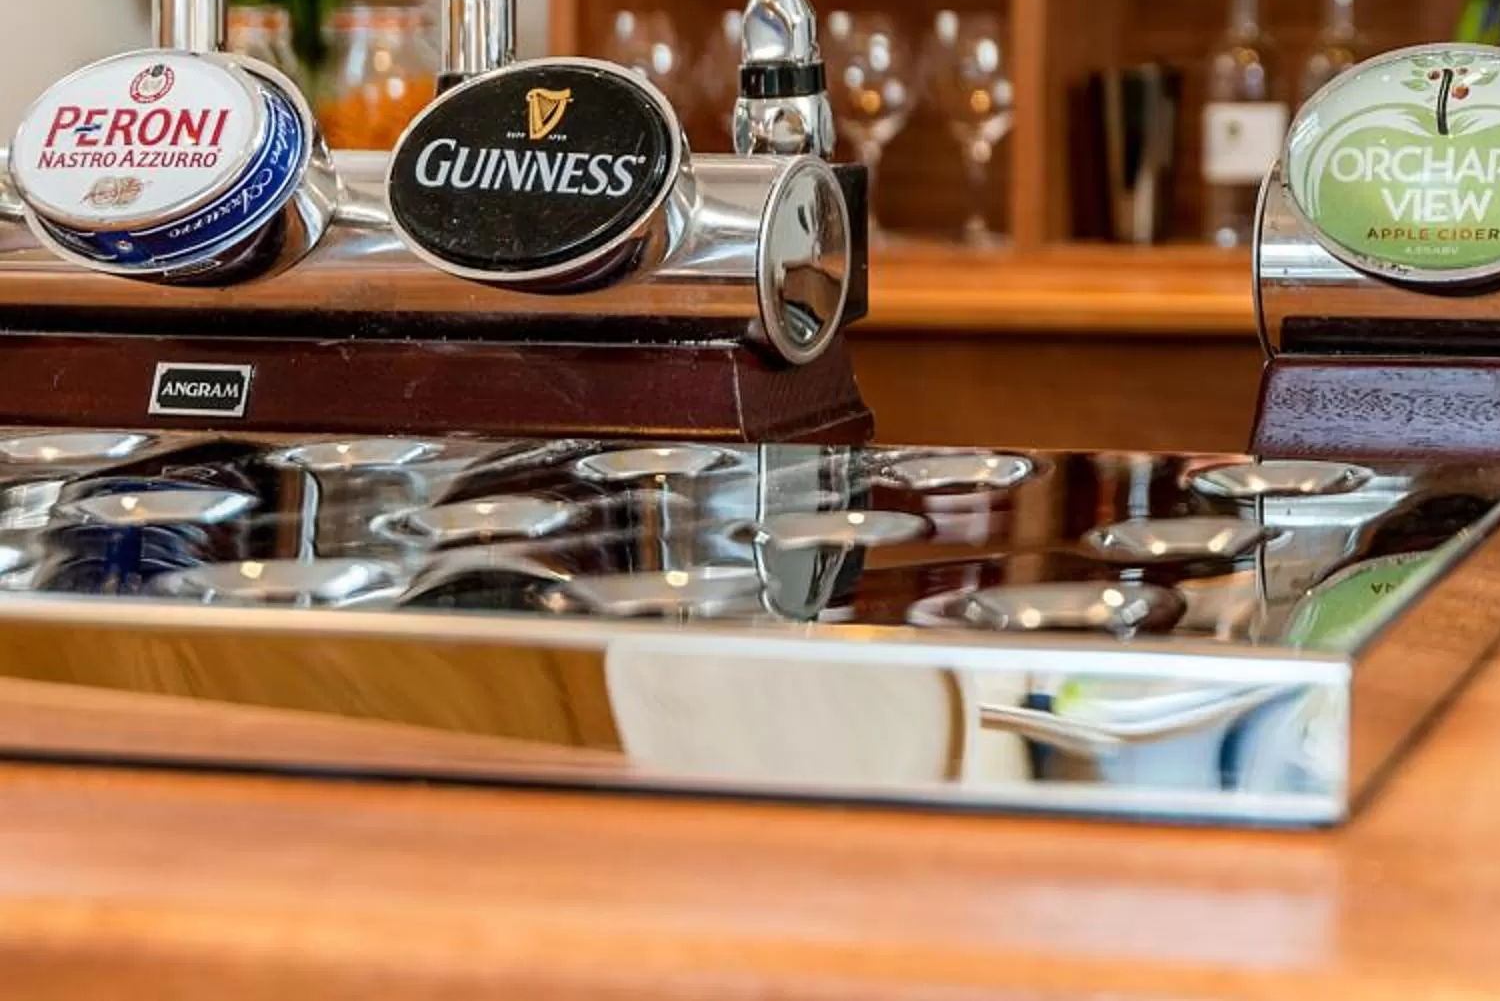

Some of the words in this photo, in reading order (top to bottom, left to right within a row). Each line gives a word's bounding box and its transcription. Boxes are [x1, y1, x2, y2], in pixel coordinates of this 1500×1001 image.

[44, 106, 231, 148] PERONI
[37, 151, 117, 169] NASTRO
[118, 149, 218, 168] AZZURRO
[415, 138, 637, 196] GUINNESS
[1381, 188, 1494, 223] VIEW
[1367, 227, 1429, 240] APPLE
[1437, 227, 1500, 240] CIDER
[161, 381, 239, 398] ANGRAM
